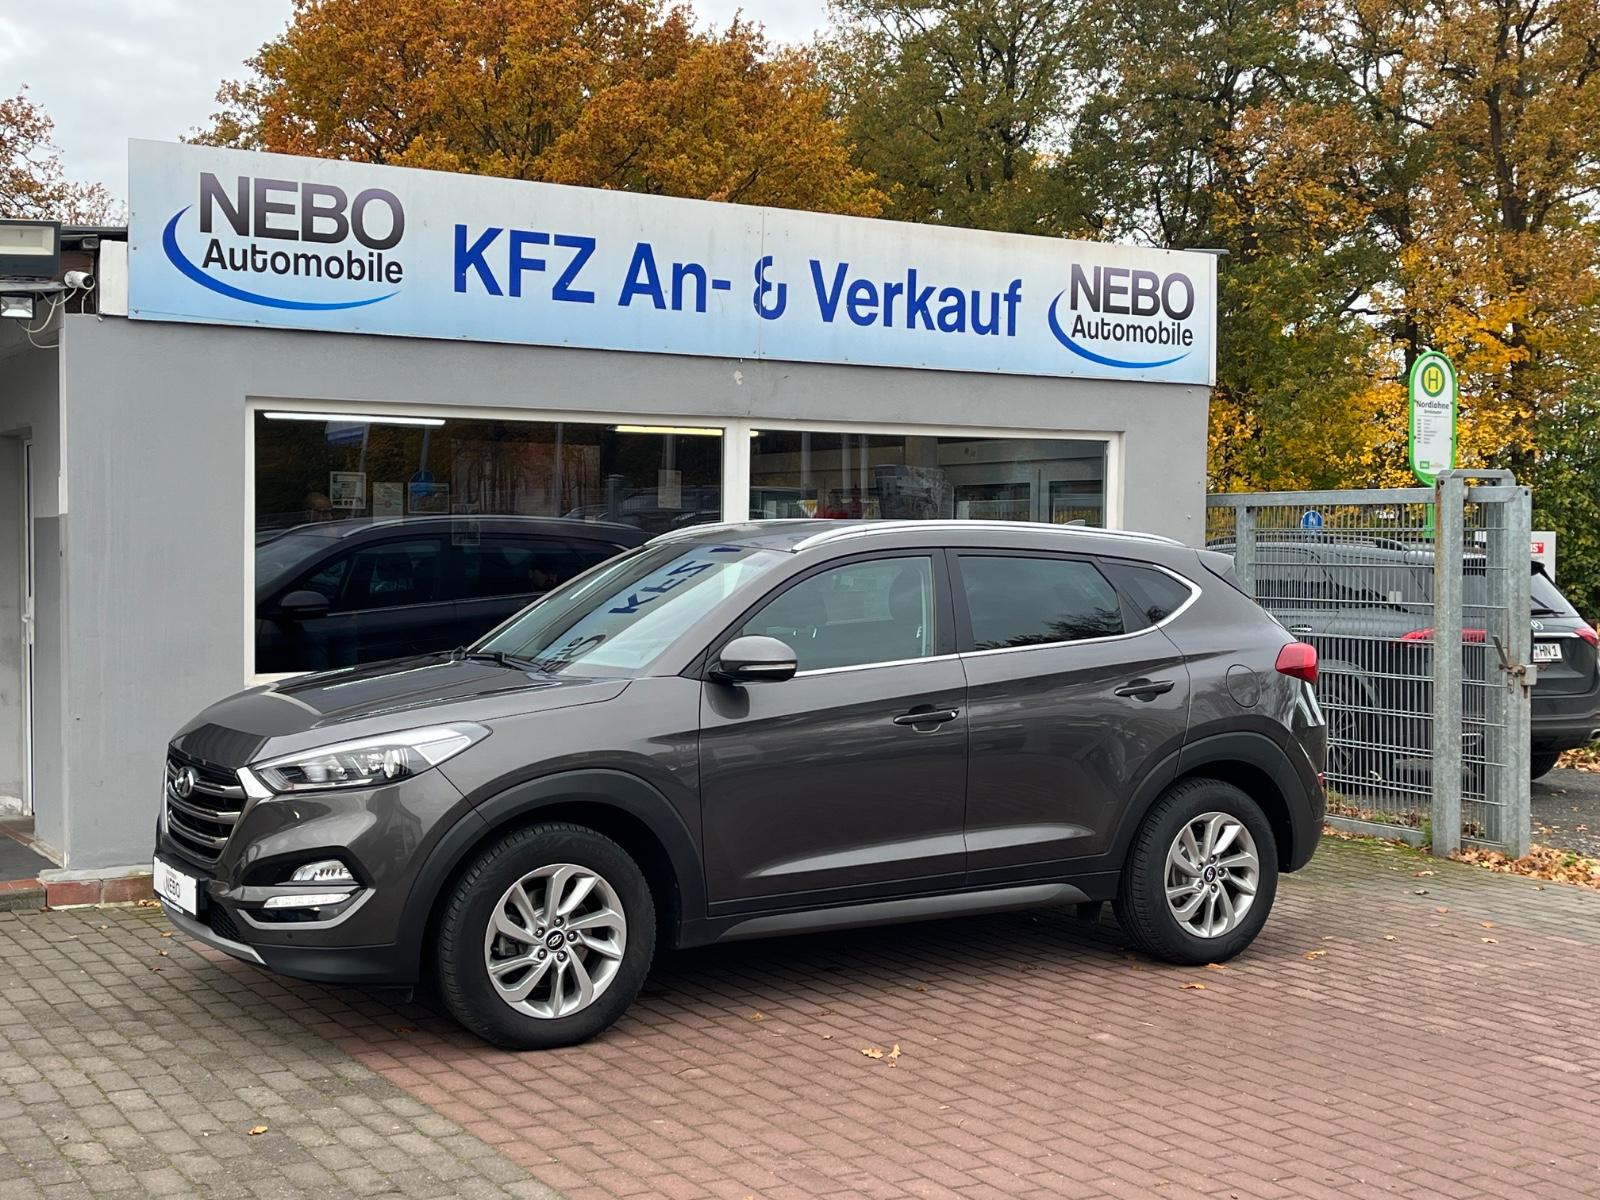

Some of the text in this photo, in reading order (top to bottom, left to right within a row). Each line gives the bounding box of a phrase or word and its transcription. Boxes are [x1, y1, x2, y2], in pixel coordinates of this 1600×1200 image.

[200, 171, 405, 250] NEBO
[201, 237, 404, 284] Automobile
[453, 223, 1023, 337] KFZ An- & Verkauf
[1070, 263, 1195, 321] NEBO
[1070, 315, 1194, 347] Automobile
[1428, 369, 1439, 390] H
